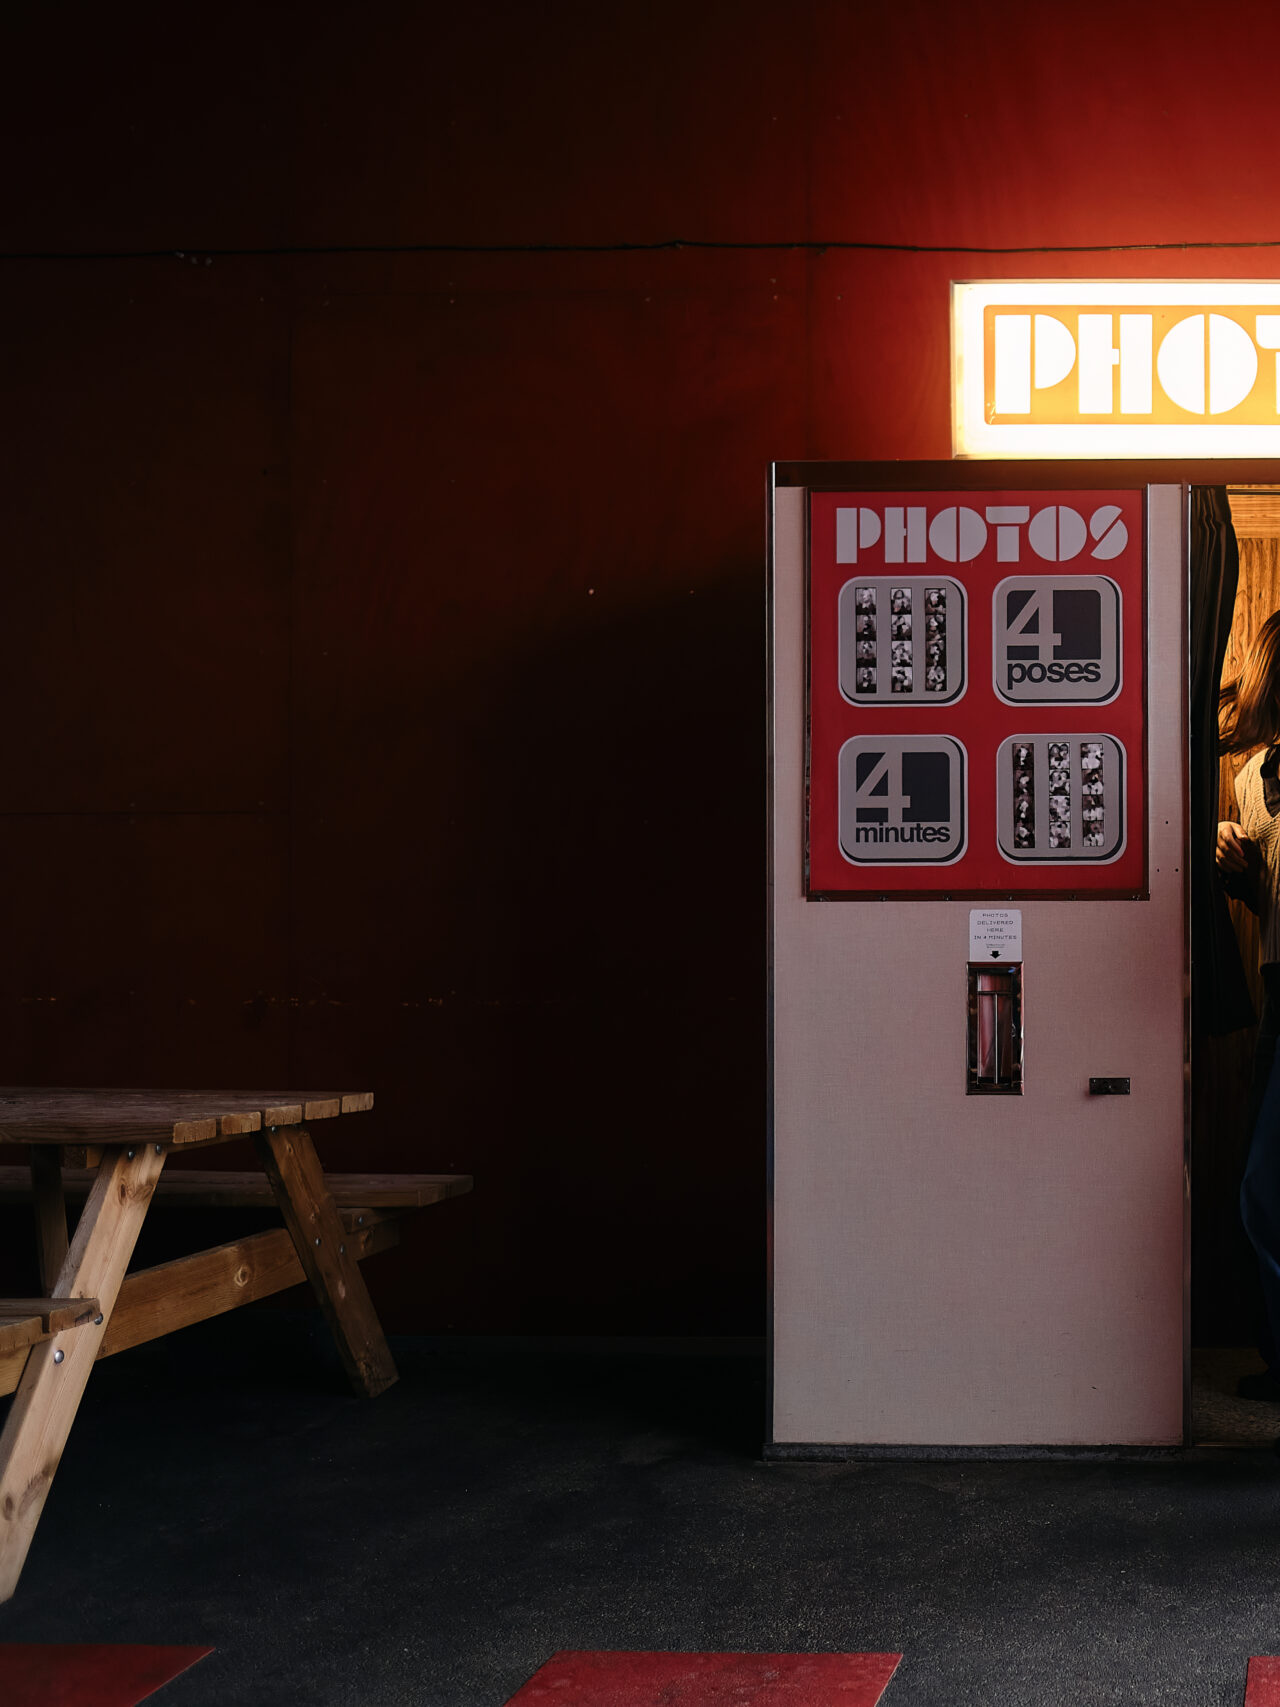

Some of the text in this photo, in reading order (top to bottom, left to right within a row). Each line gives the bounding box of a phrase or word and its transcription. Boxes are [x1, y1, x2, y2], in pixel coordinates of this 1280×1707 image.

[836, 505, 1129, 564] PHOTOS
[1006, 590, 1062, 660] 4
[1007, 661, 1101, 690] poses
[855, 752, 911, 822] 4
[855, 822, 951, 844] minutes
